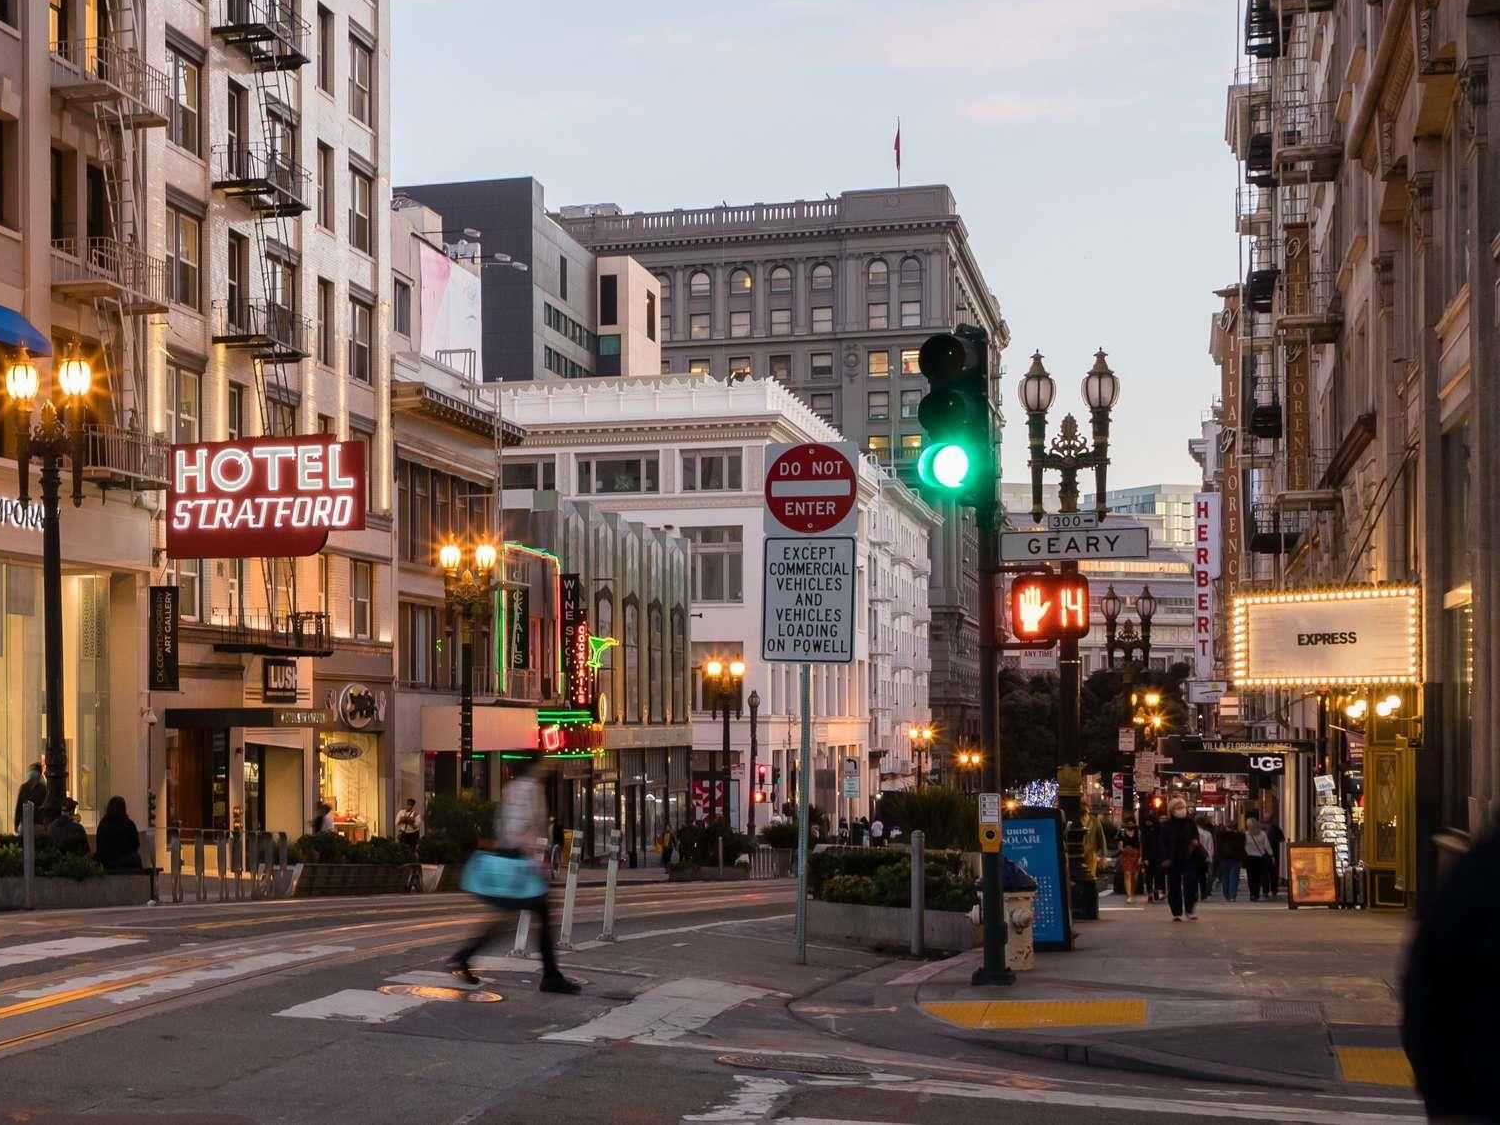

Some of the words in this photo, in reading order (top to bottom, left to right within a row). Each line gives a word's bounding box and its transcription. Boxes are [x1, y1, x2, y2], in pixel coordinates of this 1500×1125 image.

[175, 444, 355, 494] HOTEL
[779, 462, 801, 476] DO
[812, 460, 843, 475] NOT
[172, 495, 353, 529] STRATFORD
[785, 501, 836, 516] ENTER
[1219, 426, 1238, 597] FLORENCE
[1052, 515, 1081, 528] 300
[1027, 534, 1120, 555] GEARY
[783, 546, 836, 561] EXCEPT
[769, 562, 849, 576] COMMERCIAL
[776, 577, 842, 592] VEHICLES
[1196, 501, 1209, 657] HERBERT
[564, 579, 575, 621] WINE
[795, 593, 823, 607] AND
[1060, 587, 1084, 628] 14
[164, 592, 172, 633] GALLERY
[775, 608, 842, 623] VEHICLES
[778, 624, 838, 638] LOADING
[1297, 631, 1357, 646] EXPRESS
[164, 635, 172, 653] ART
[767, 639, 785, 653] ON
[793, 638, 848, 654] POWELL
[1024, 650, 1037, 658] ANY
[578, 625, 586, 704] COCKTAILS
[1202, 741, 1225, 750] VILLA
[1250, 756, 1283, 772] UGG
[1002, 834, 1042, 844] SQUARE
[1006, 828, 1035, 836] UNION
